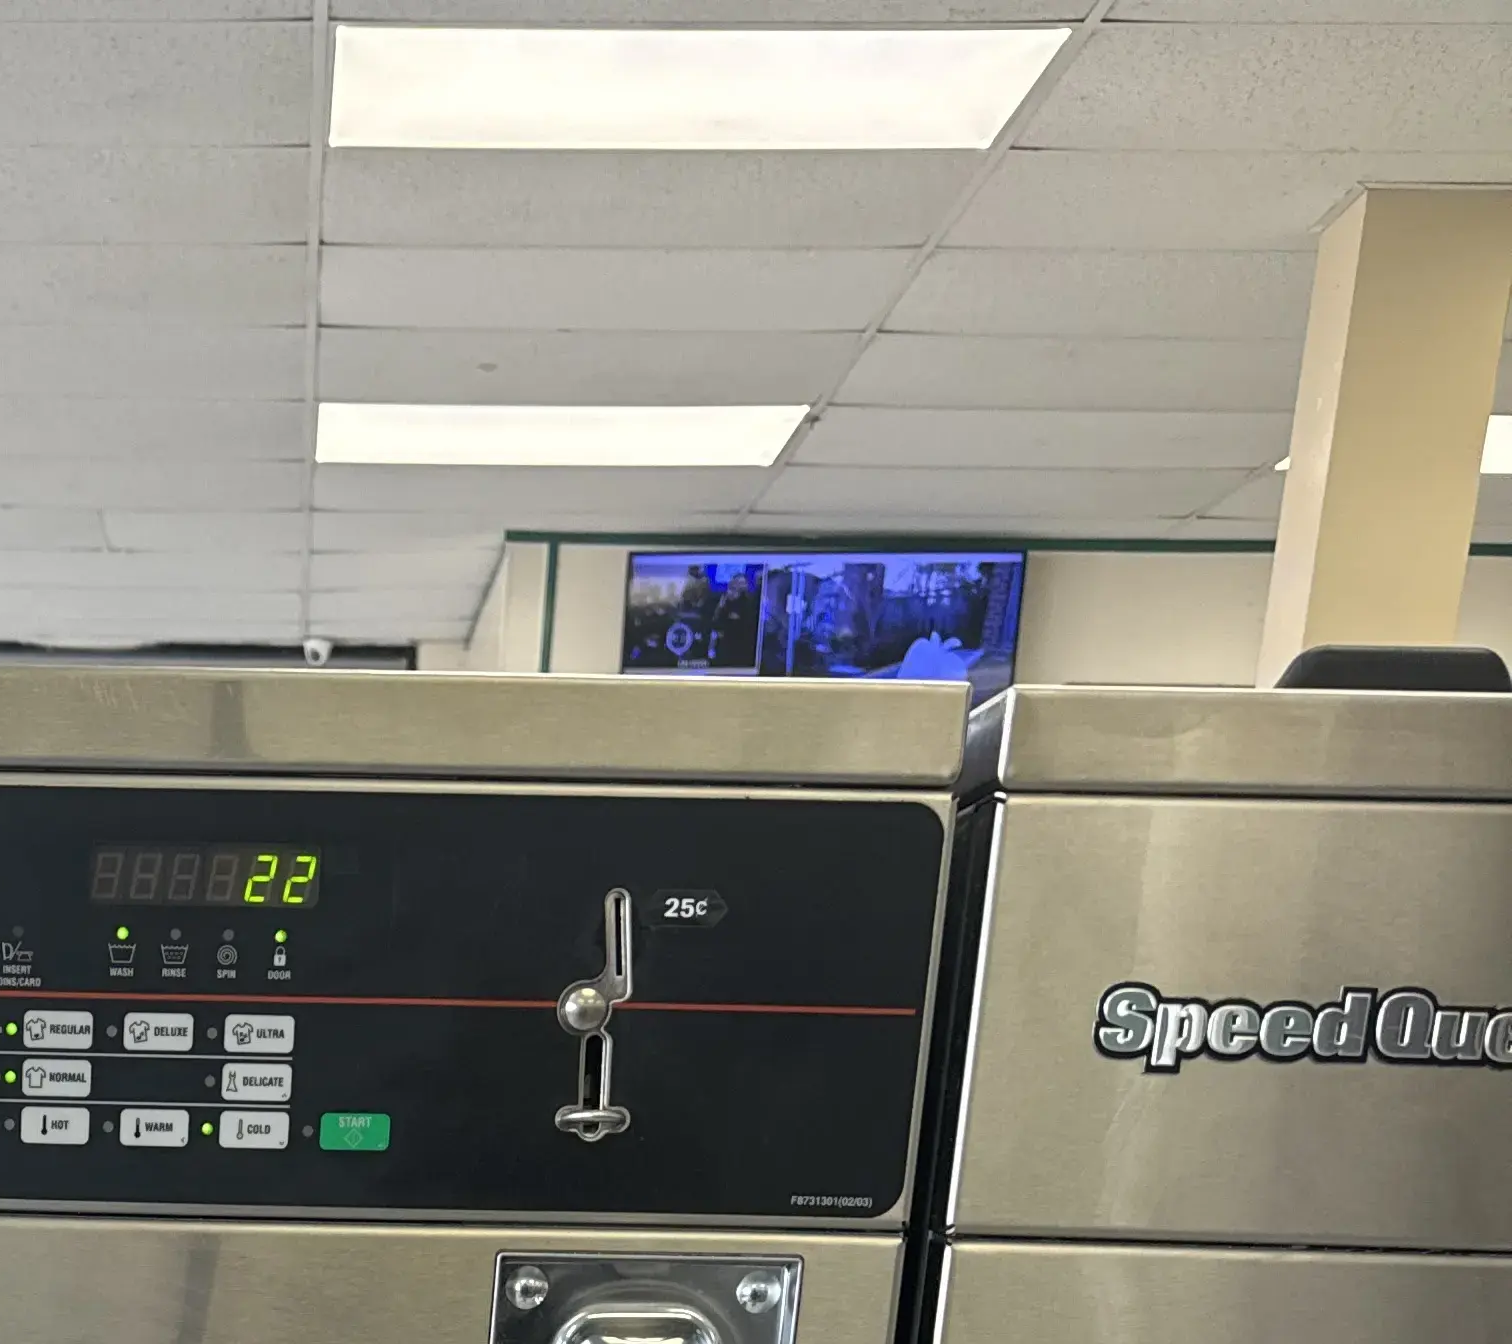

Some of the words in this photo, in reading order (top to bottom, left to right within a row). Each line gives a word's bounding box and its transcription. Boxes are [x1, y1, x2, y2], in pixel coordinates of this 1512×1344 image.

[243, 853, 317, 905] 22
[664, 897, 708, 920] 25¢
[2, 965, 31, 975] INSERT
[109, 967, 134, 978] WASH
[161, 967, 187, 978] RINSE
[216, 969, 236, 980] SPIN
[267, 970, 291, 980] DOOR
[49, 1024, 91, 1036] REGULAR
[154, 1026, 188, 1038] DELUXE
[256, 1028, 285, 1039] ULTRA
[1093, 982, 1377, 1073] Speed
[49, 1071, 87, 1083] NORMAL
[242, 1075, 284, 1088] DELICATE
[51, 1120, 69, 1130] HOT
[144, 1121, 174, 1133] WARM
[338, 1115, 373, 1128] START
[247, 1124, 271, 1135] COLD
